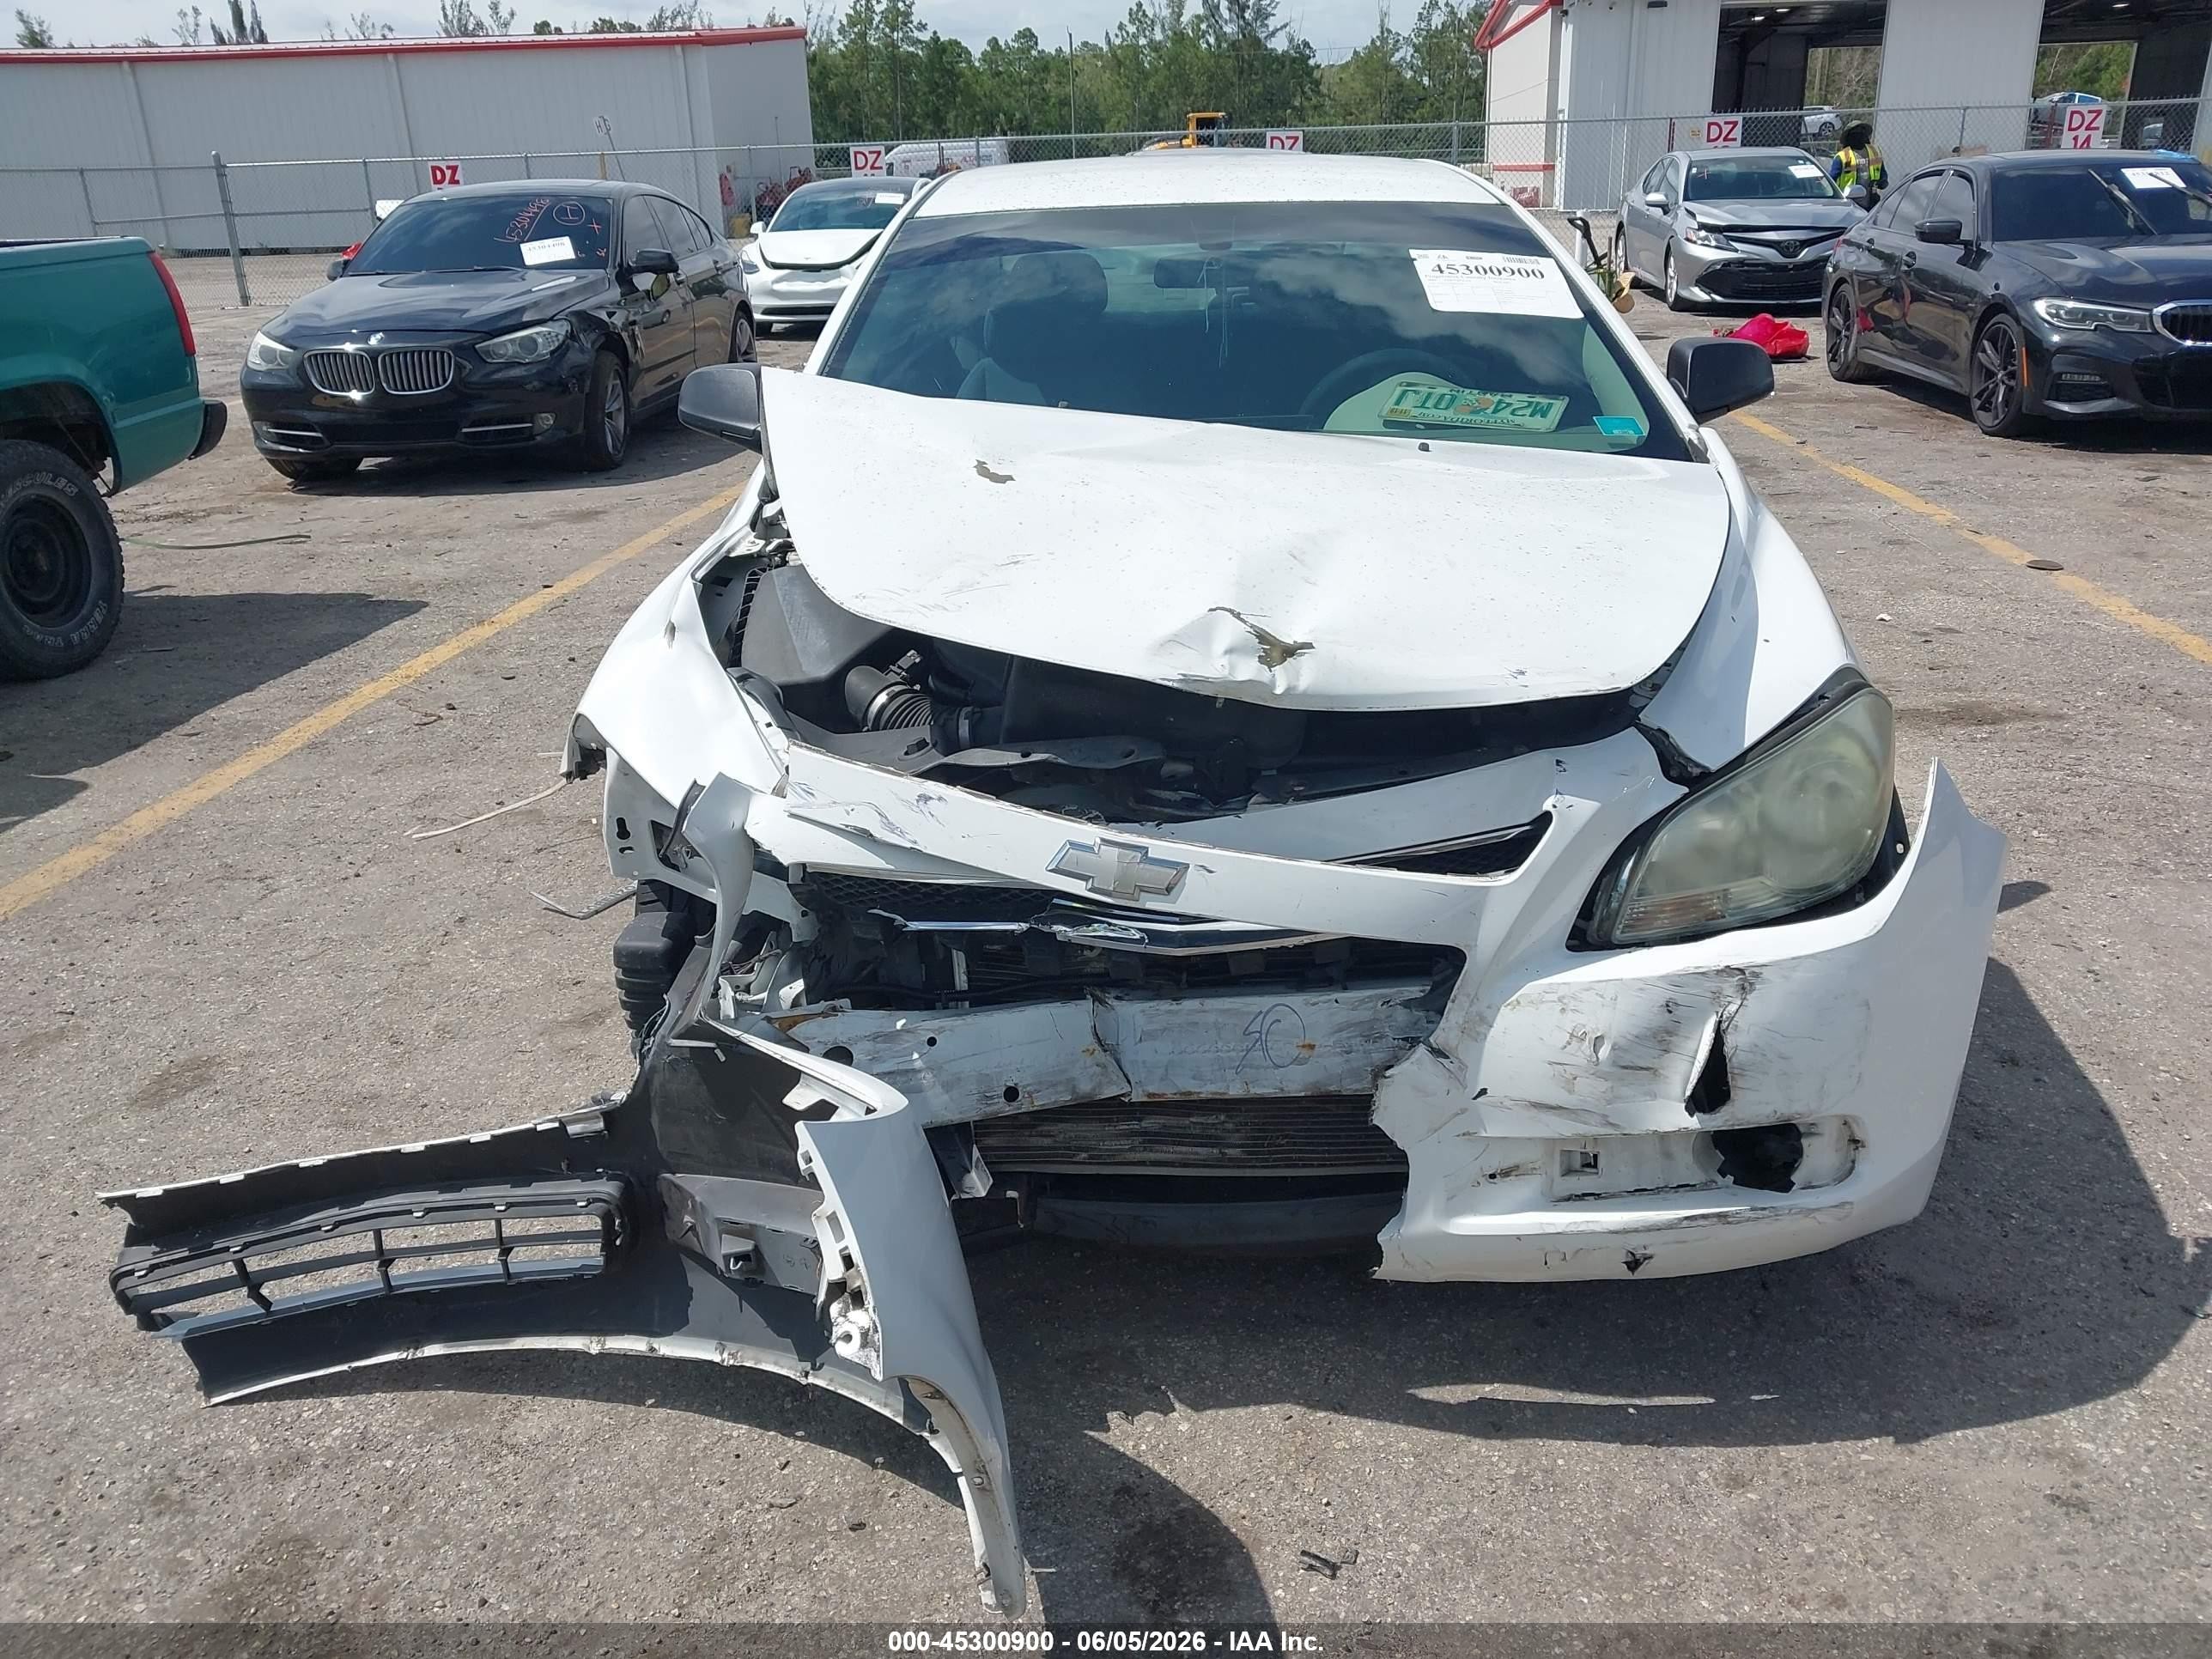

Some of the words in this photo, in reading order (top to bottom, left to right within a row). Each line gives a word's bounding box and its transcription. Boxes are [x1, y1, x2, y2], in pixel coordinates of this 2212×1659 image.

[2068, 109, 2103, 131] DZ
[1706, 121, 1739, 143] DZ
[1270, 136, 1299, 150] DZ
[853, 150, 884, 170] DZ
[430, 164, 460, 185] DZ
[1431, 264, 1544, 280] 45300900
